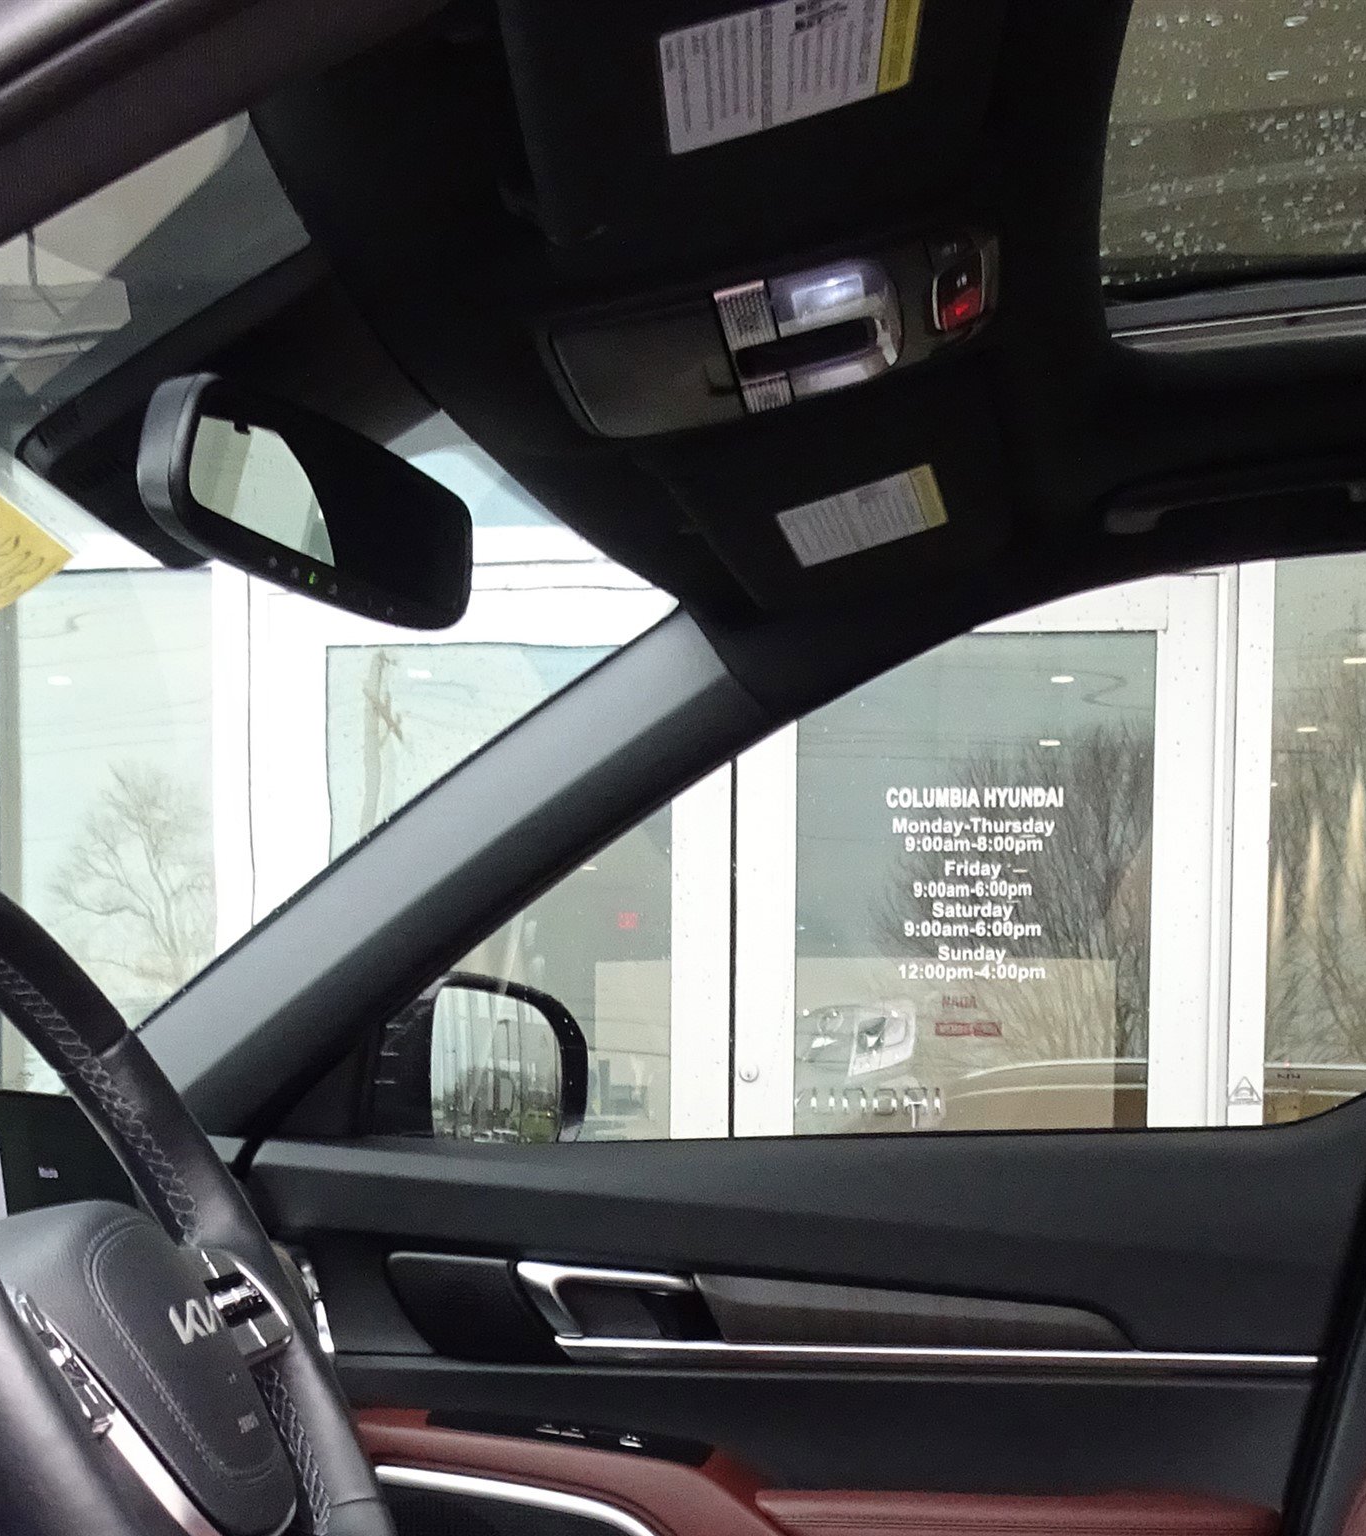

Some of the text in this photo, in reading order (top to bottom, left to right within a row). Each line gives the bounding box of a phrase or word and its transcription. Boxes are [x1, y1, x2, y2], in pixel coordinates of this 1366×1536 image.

[885, 787, 1064, 809] COLUMBIA HYUNDAI
[892, 818, 1055, 837] Monday-Thursday
[904, 836, 1043, 855] 9:00am-8:00pm
[944, 860, 1002, 880] Friday
[913, 882, 1032, 901] 9:00am-6:00pm
[932, 902, 1013, 921] Saturday
[904, 921, 1042, 940] 9:00am-6:00pm
[937, 946, 1006, 965] Sunday
[898, 964, 1046, 982] 12:00pm-4:00pm
